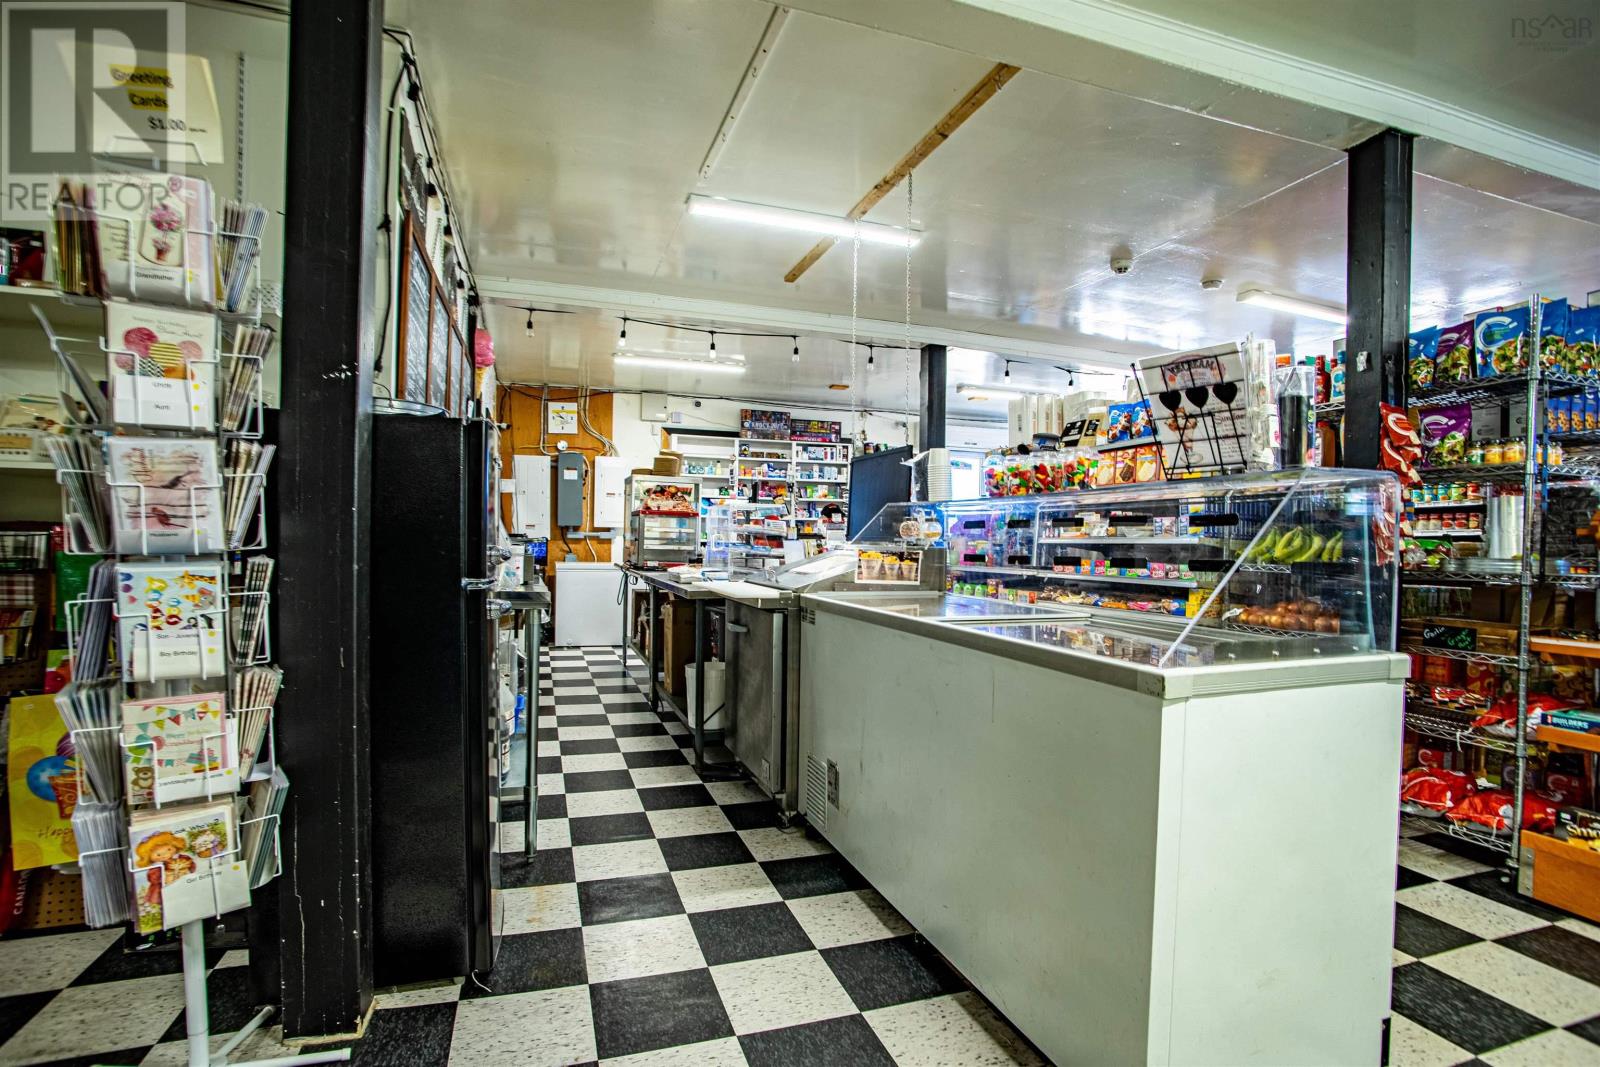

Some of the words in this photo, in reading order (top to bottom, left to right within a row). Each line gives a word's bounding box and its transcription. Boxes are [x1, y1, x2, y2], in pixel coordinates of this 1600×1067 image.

[111, 68, 175, 89] Greeting
[128, 92, 169, 108] Cards
[147, 115, 187, 132] $1.00
[172, 649, 198, 658] Birthday
